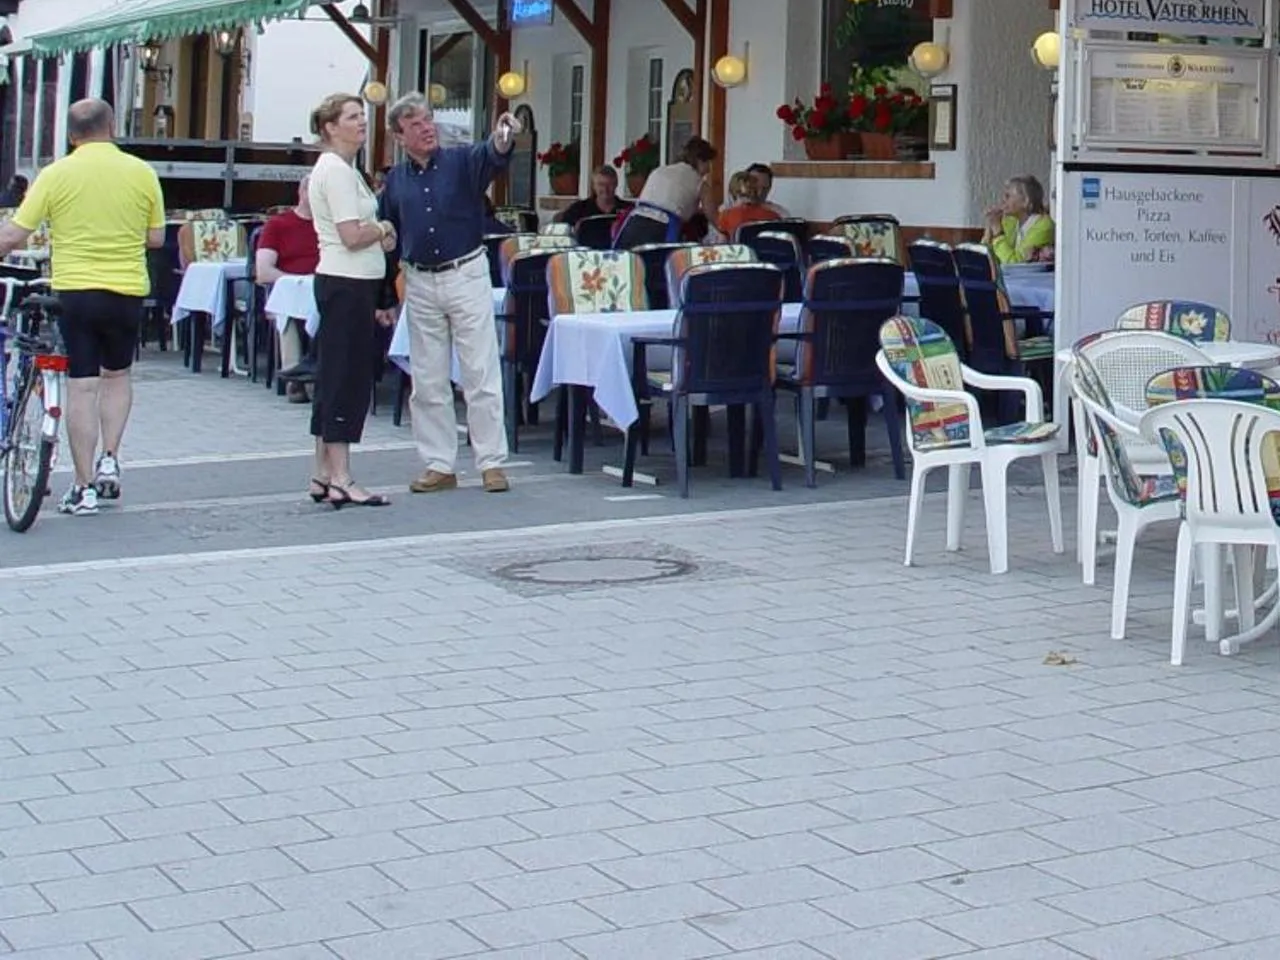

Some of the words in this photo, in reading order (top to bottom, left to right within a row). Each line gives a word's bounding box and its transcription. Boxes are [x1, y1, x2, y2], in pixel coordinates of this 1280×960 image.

[1202, 2, 1250, 20] RHEIN
[1104, 186, 1204, 206] Hausgebackene
[1137, 207, 1171, 222] Pizza
[1086, 227, 1138, 243] Kuchen,
[1143, 228, 1184, 244] Torten,
[1188, 229, 1227, 244] Kaffee
[1130, 248, 1155, 263] und
[1159, 249, 1176, 263] Eis
